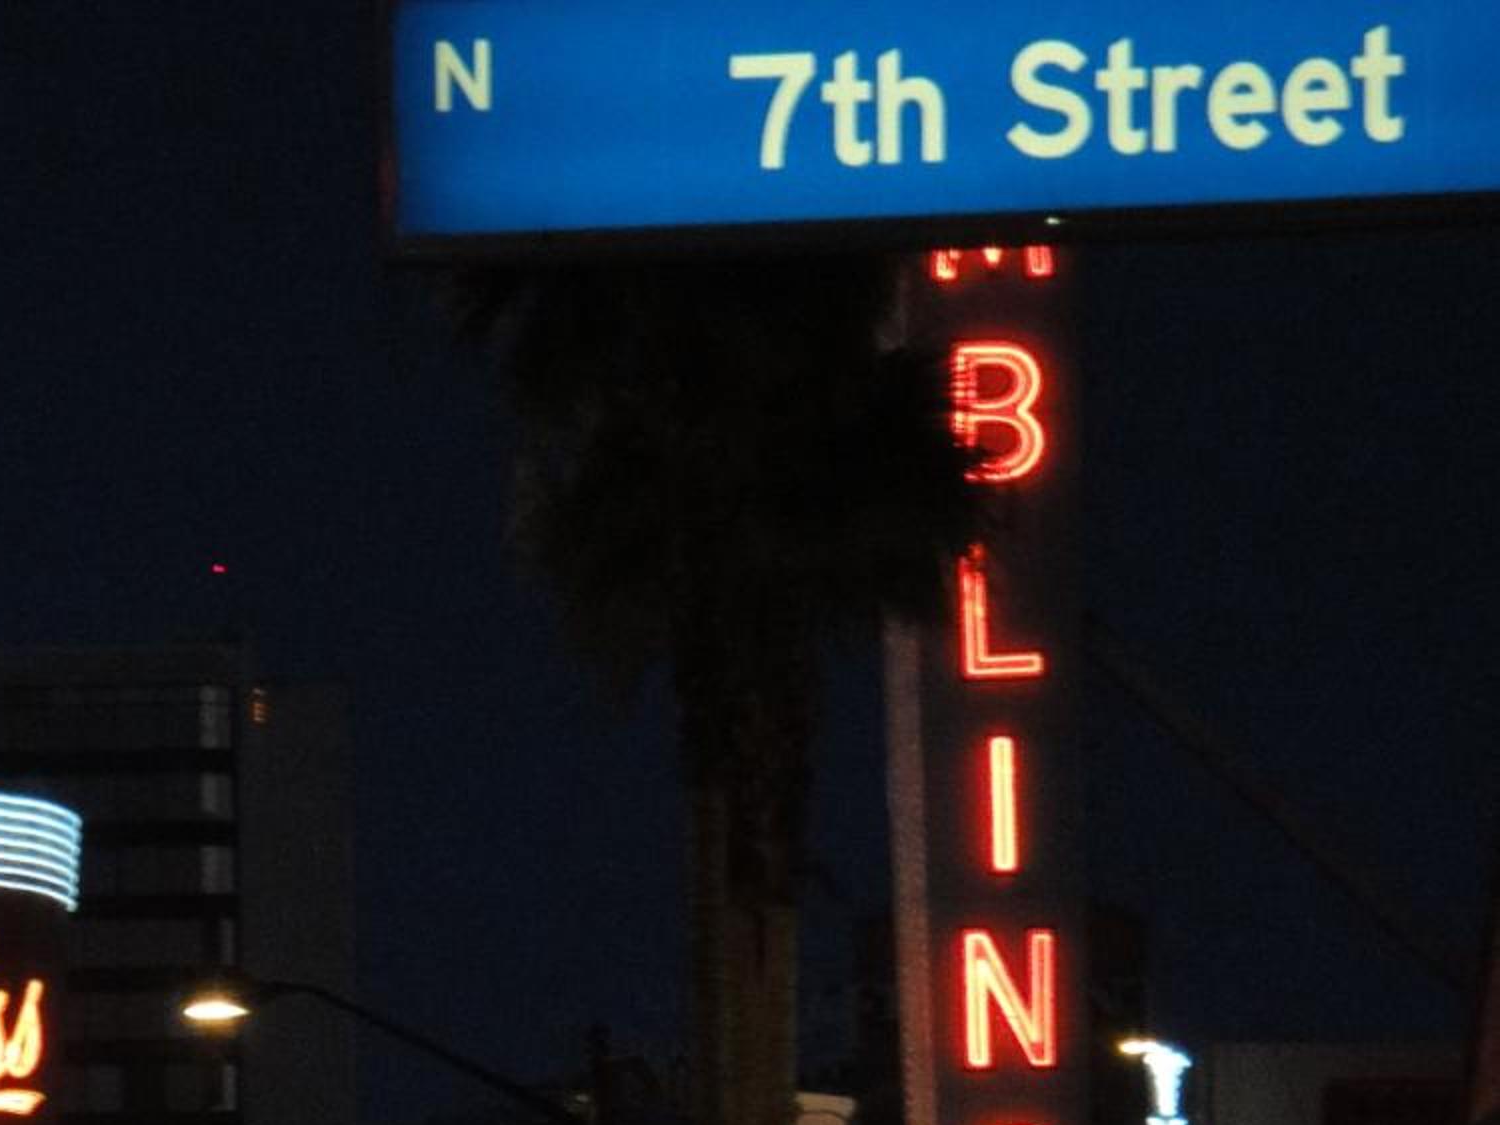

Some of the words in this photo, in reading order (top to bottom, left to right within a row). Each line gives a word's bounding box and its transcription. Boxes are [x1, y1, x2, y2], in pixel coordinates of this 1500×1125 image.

[435, 39, 492, 111] N
[729, 48, 946, 170] 7th
[1006, 25, 1404, 161] Street
